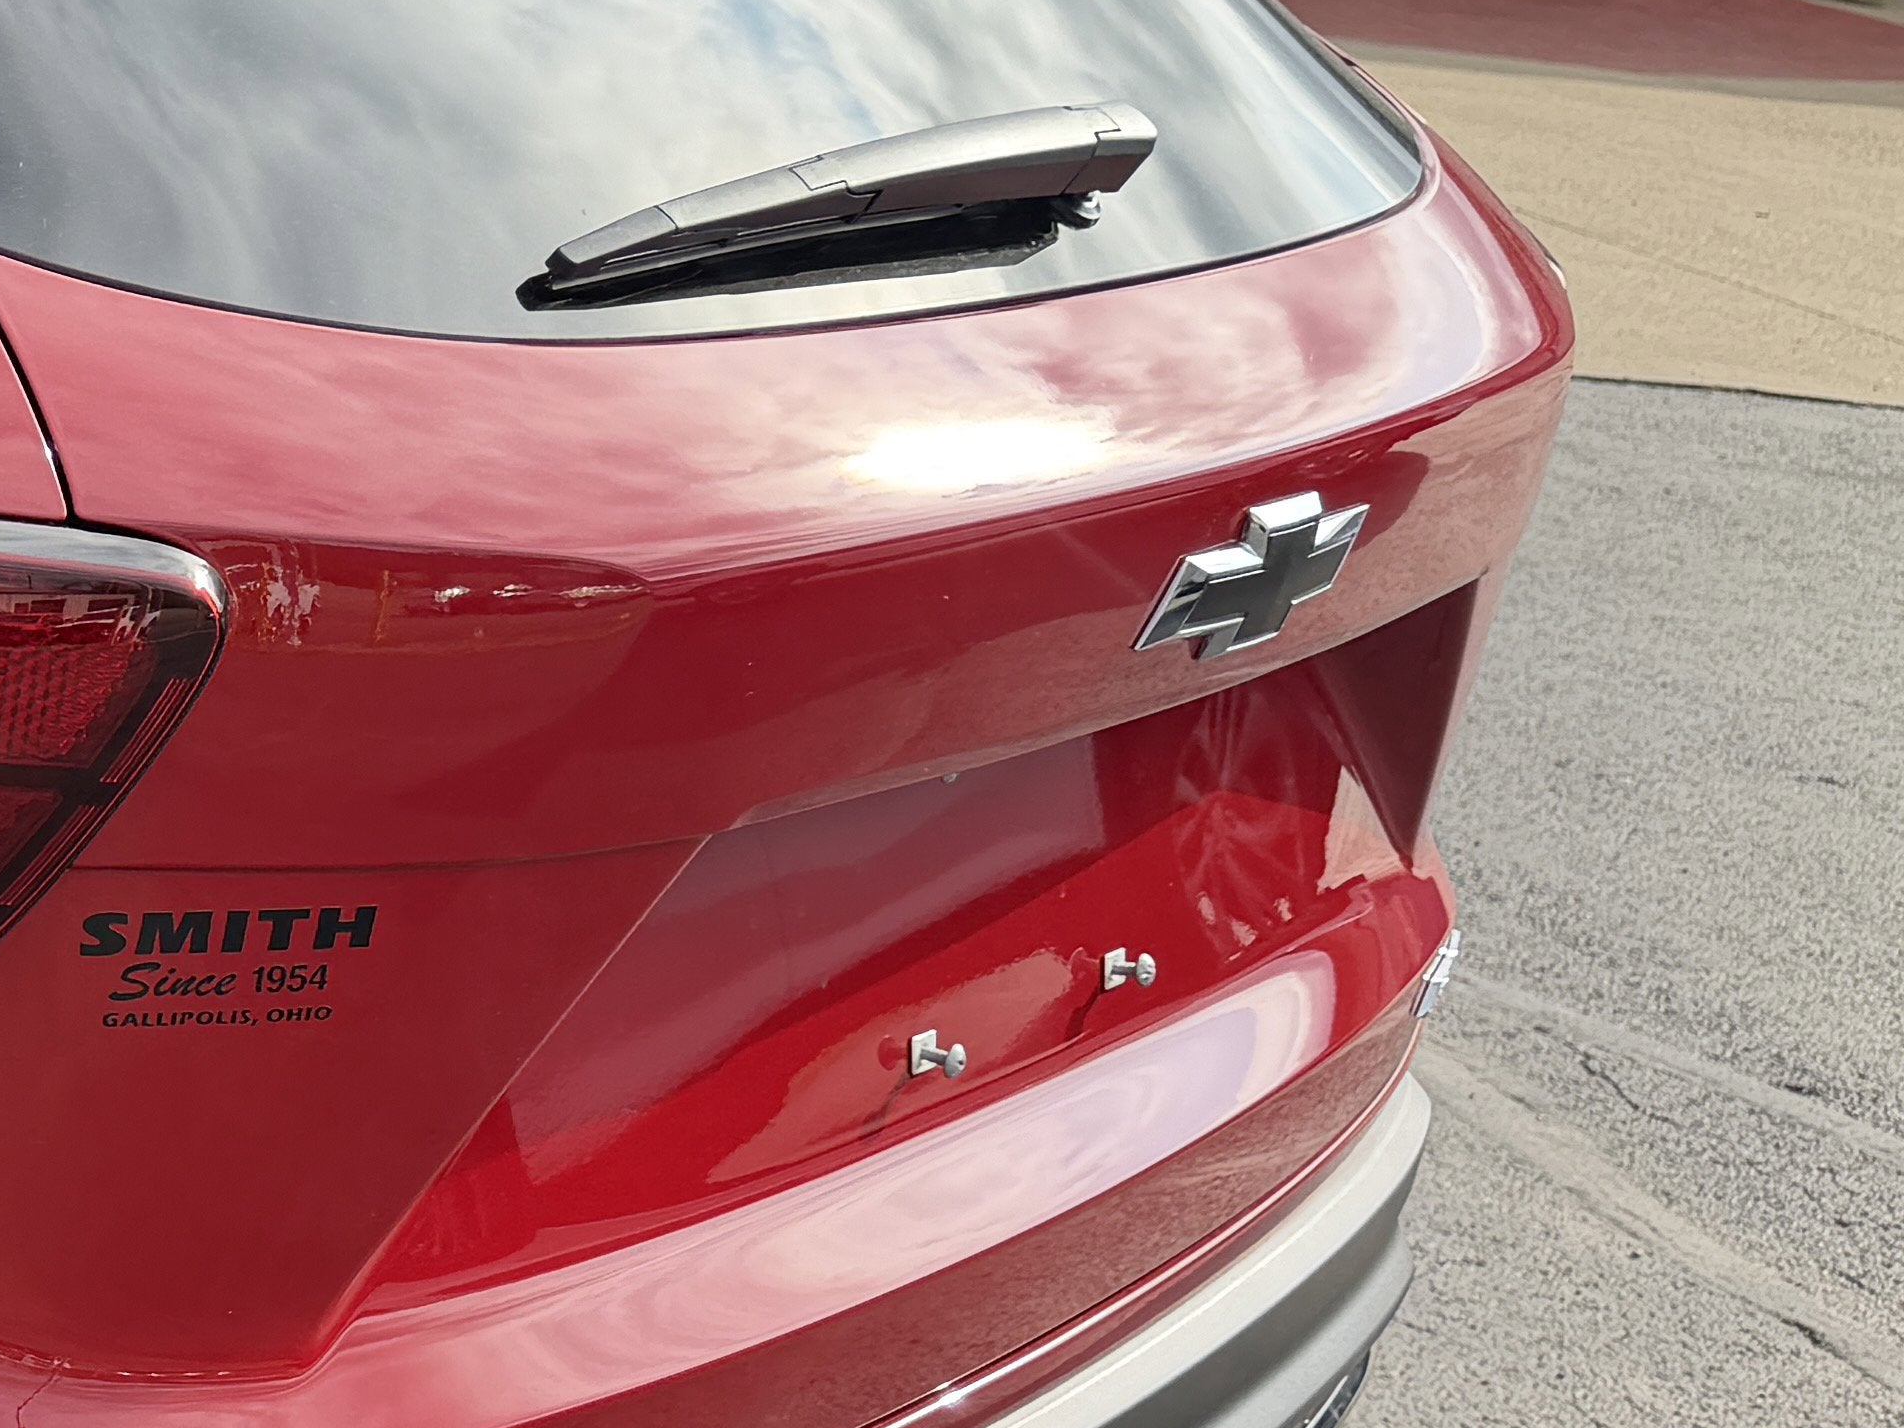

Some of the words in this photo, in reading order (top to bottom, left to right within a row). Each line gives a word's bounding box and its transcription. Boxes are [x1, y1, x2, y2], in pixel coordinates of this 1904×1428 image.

[79, 905, 379, 957] SMITH
[107, 960, 238, 1002] Since
[252, 963, 329, 993] 1954
[101, 1006, 259, 1028] GALLIPOLIS,
[265, 1005, 333, 1023] OHIO
